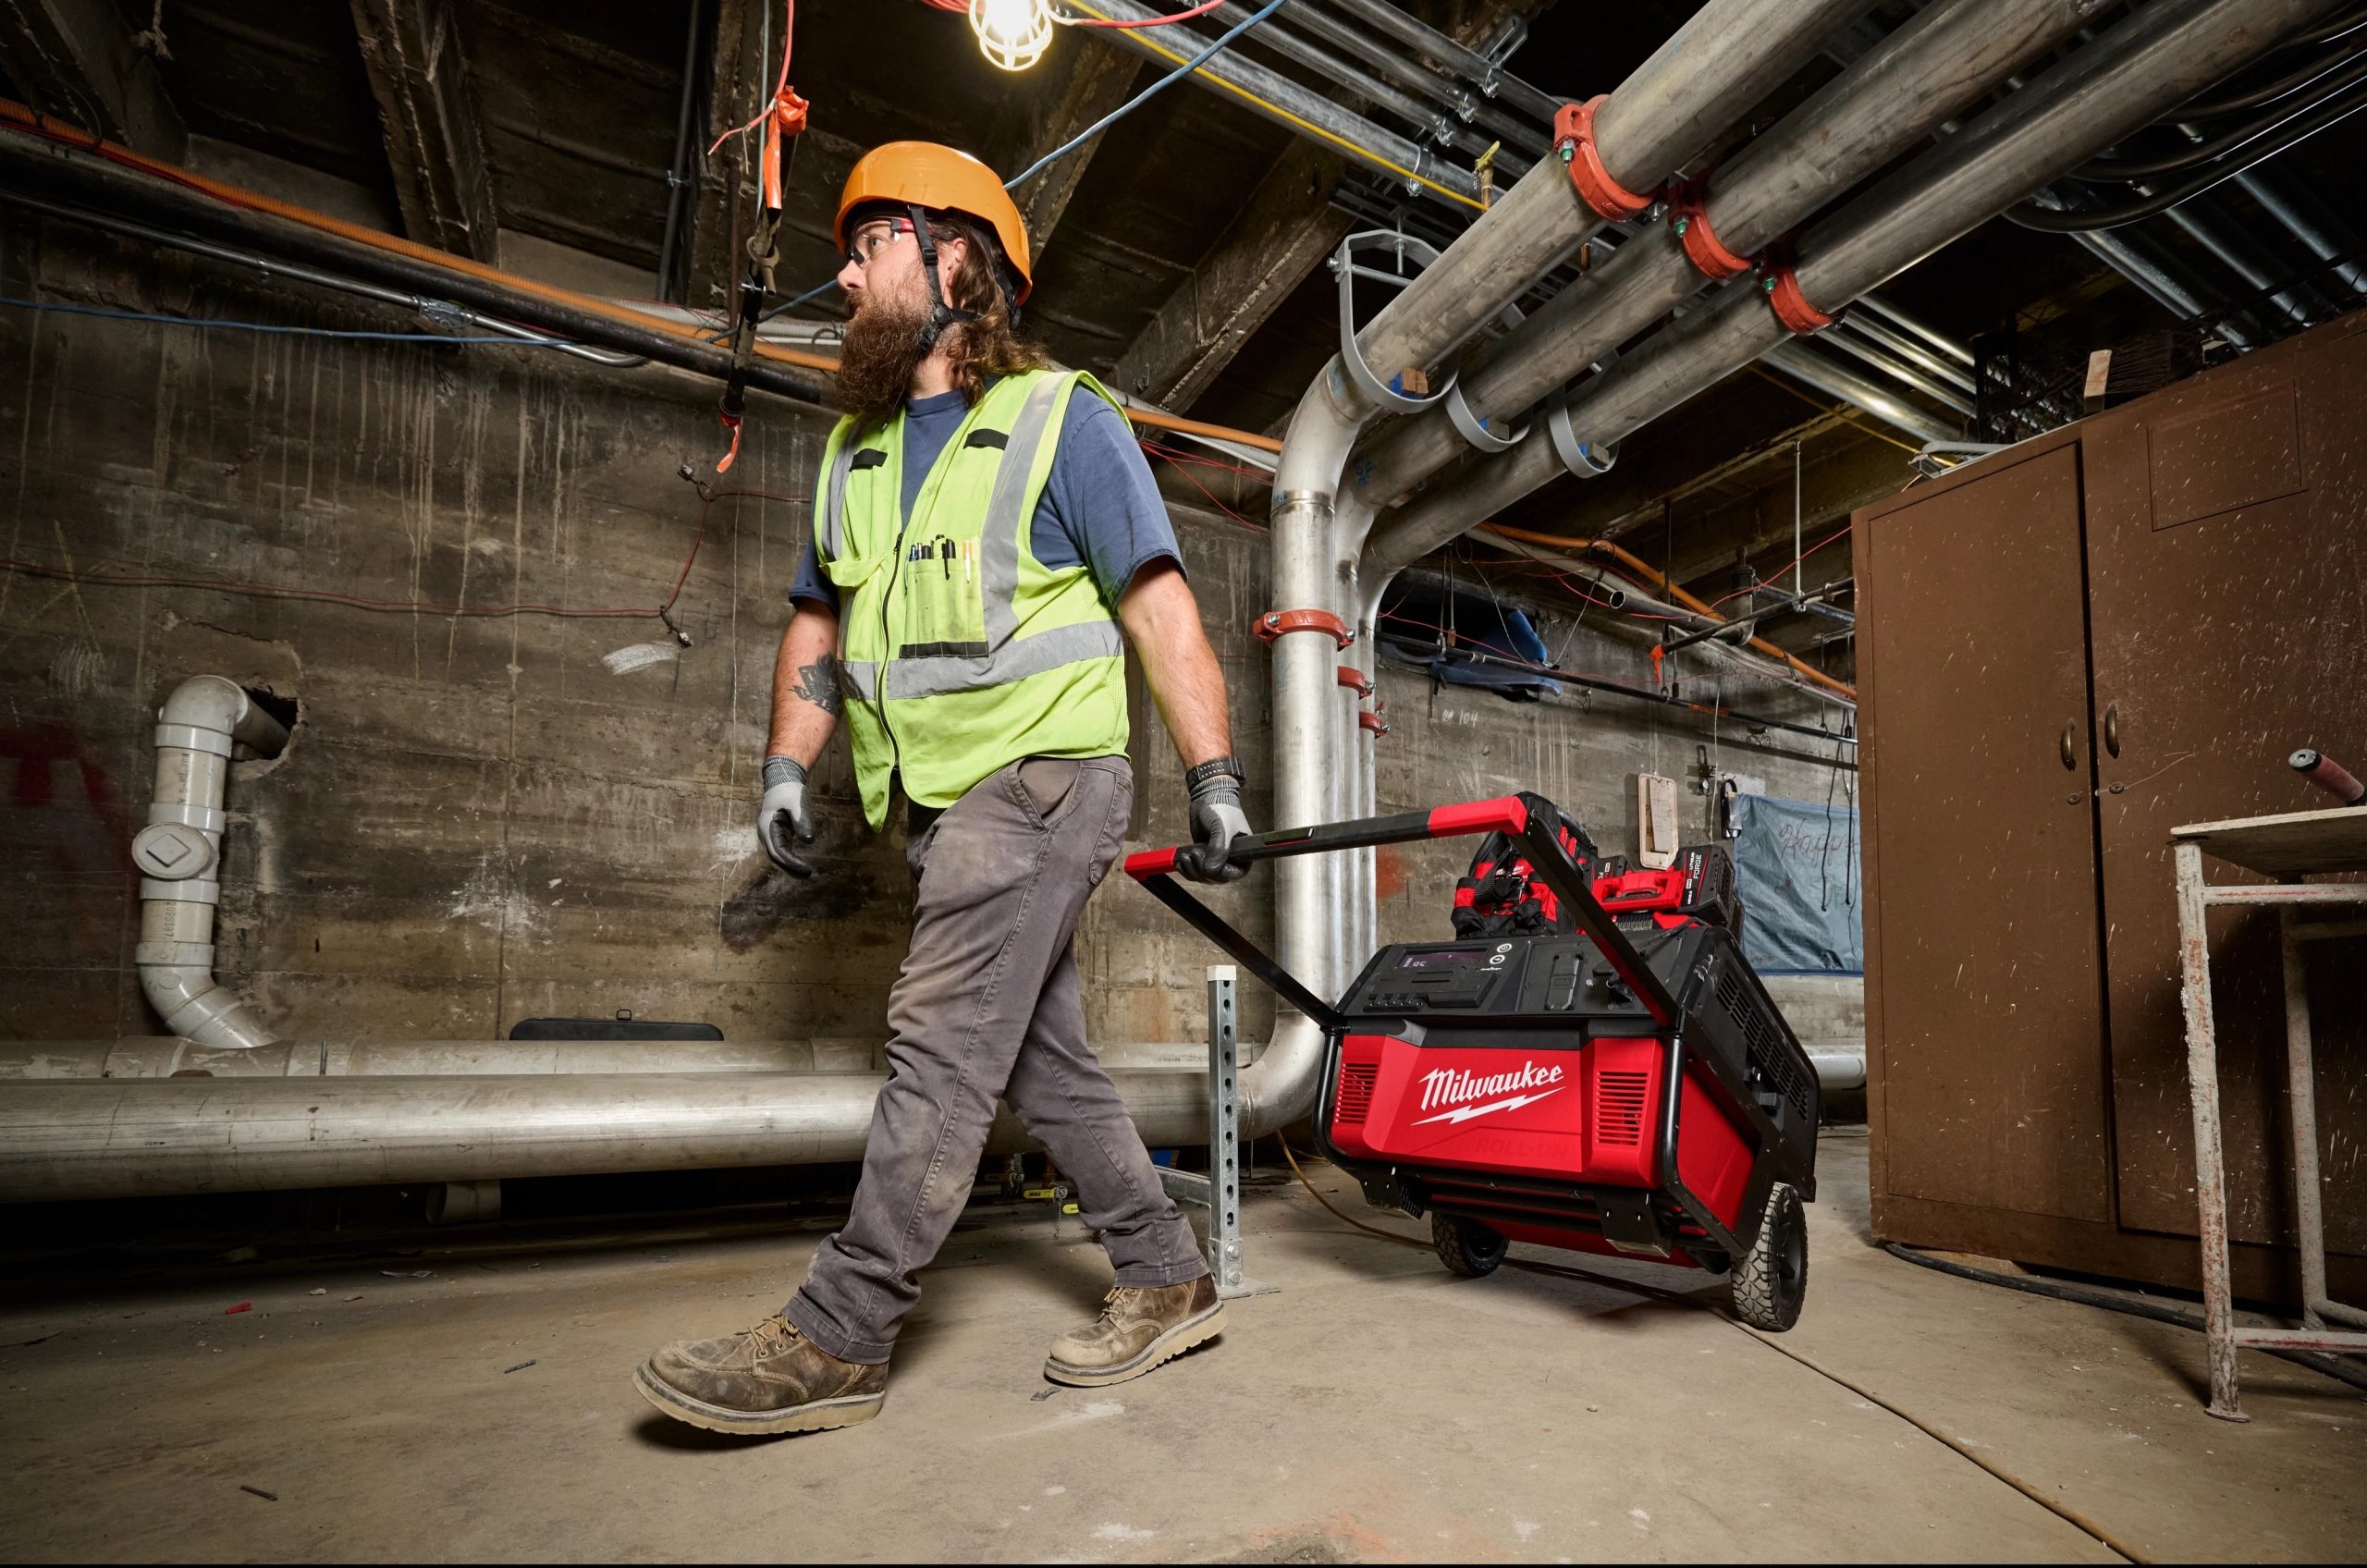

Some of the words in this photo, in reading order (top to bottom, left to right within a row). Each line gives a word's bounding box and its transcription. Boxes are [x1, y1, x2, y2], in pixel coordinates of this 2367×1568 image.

[1459, 710, 1479, 728] 104
[1693, 854, 1702, 879] FORGE
[1417, 1060, 1564, 1111] Milwaukee
